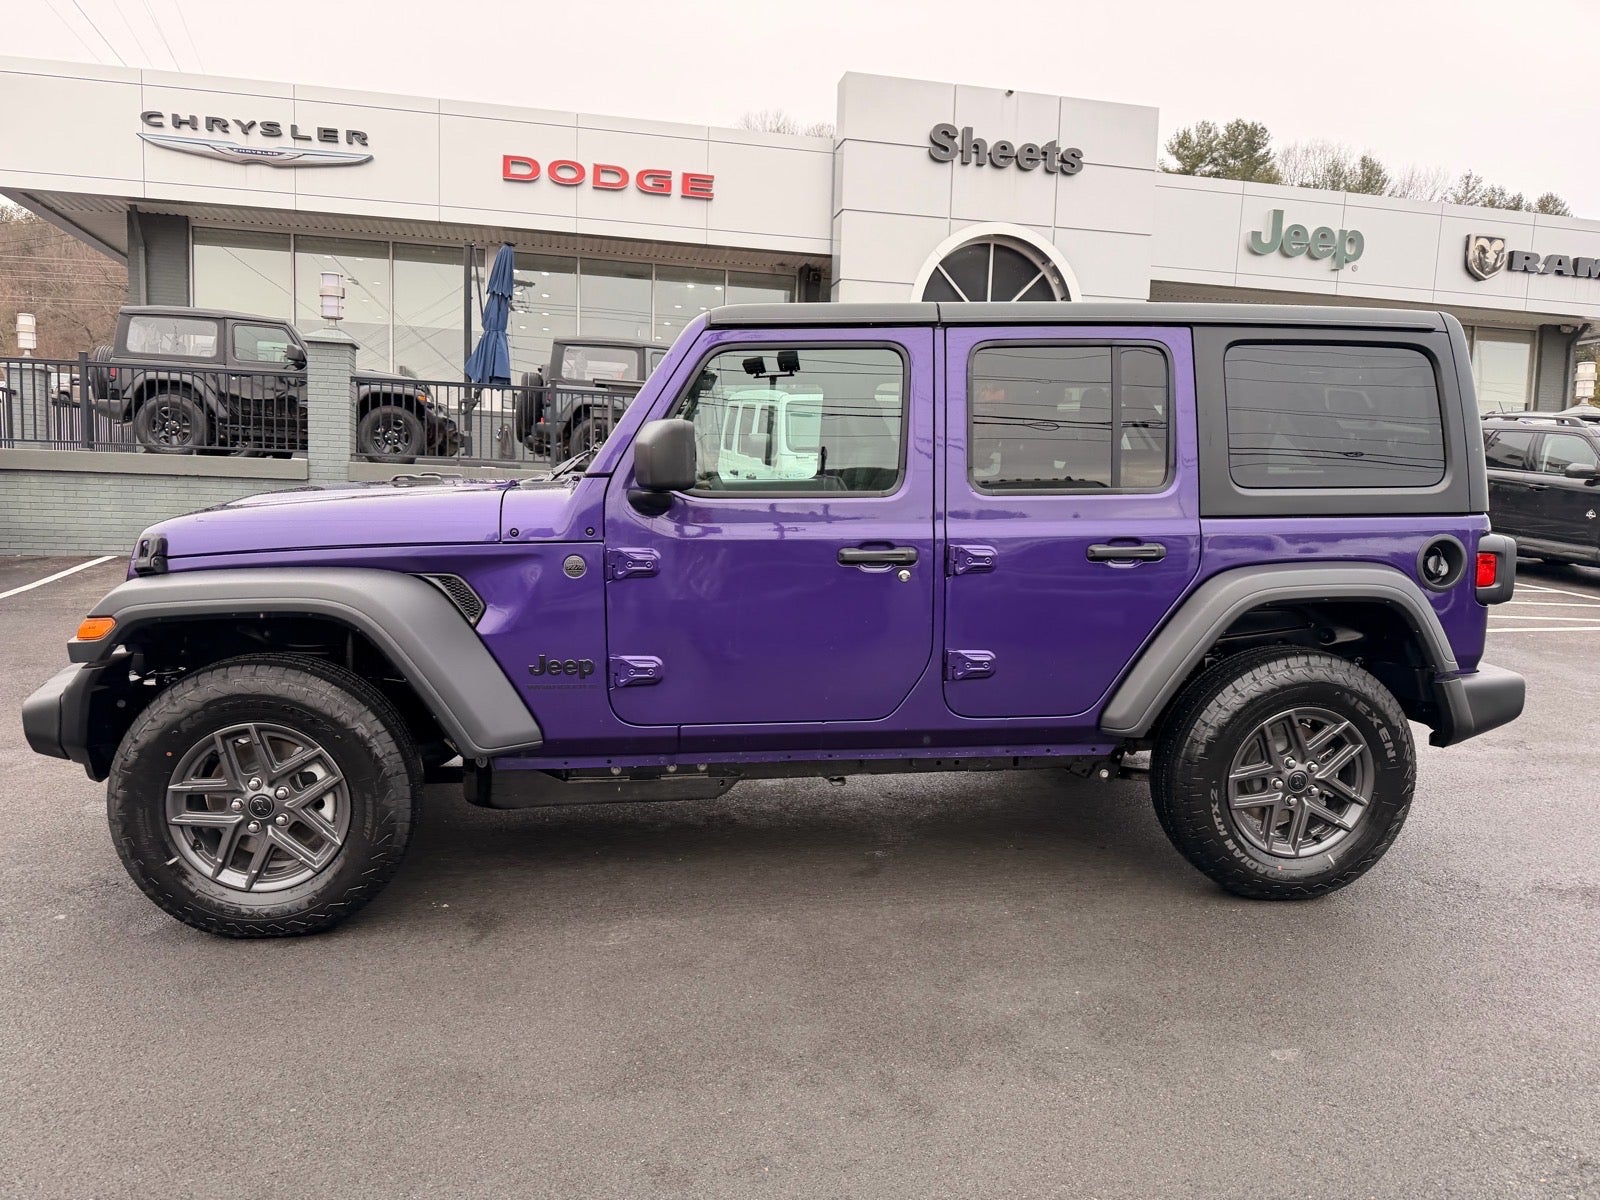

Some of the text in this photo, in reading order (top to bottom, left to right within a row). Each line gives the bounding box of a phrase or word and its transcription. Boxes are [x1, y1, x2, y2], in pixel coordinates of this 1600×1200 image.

[140, 110, 368, 146] CHRYSLER
[233, 148, 279, 156] CHRYSLER
[929, 123, 1084, 175] Sheets
[502, 154, 715, 200] DODGE
[1248, 209, 1365, 271] Jeep
[528, 653, 595, 679] Jeep
[1343, 692, 1397, 759] NEXEN
[1210, 788, 1288, 880] OADIAN HTX2
